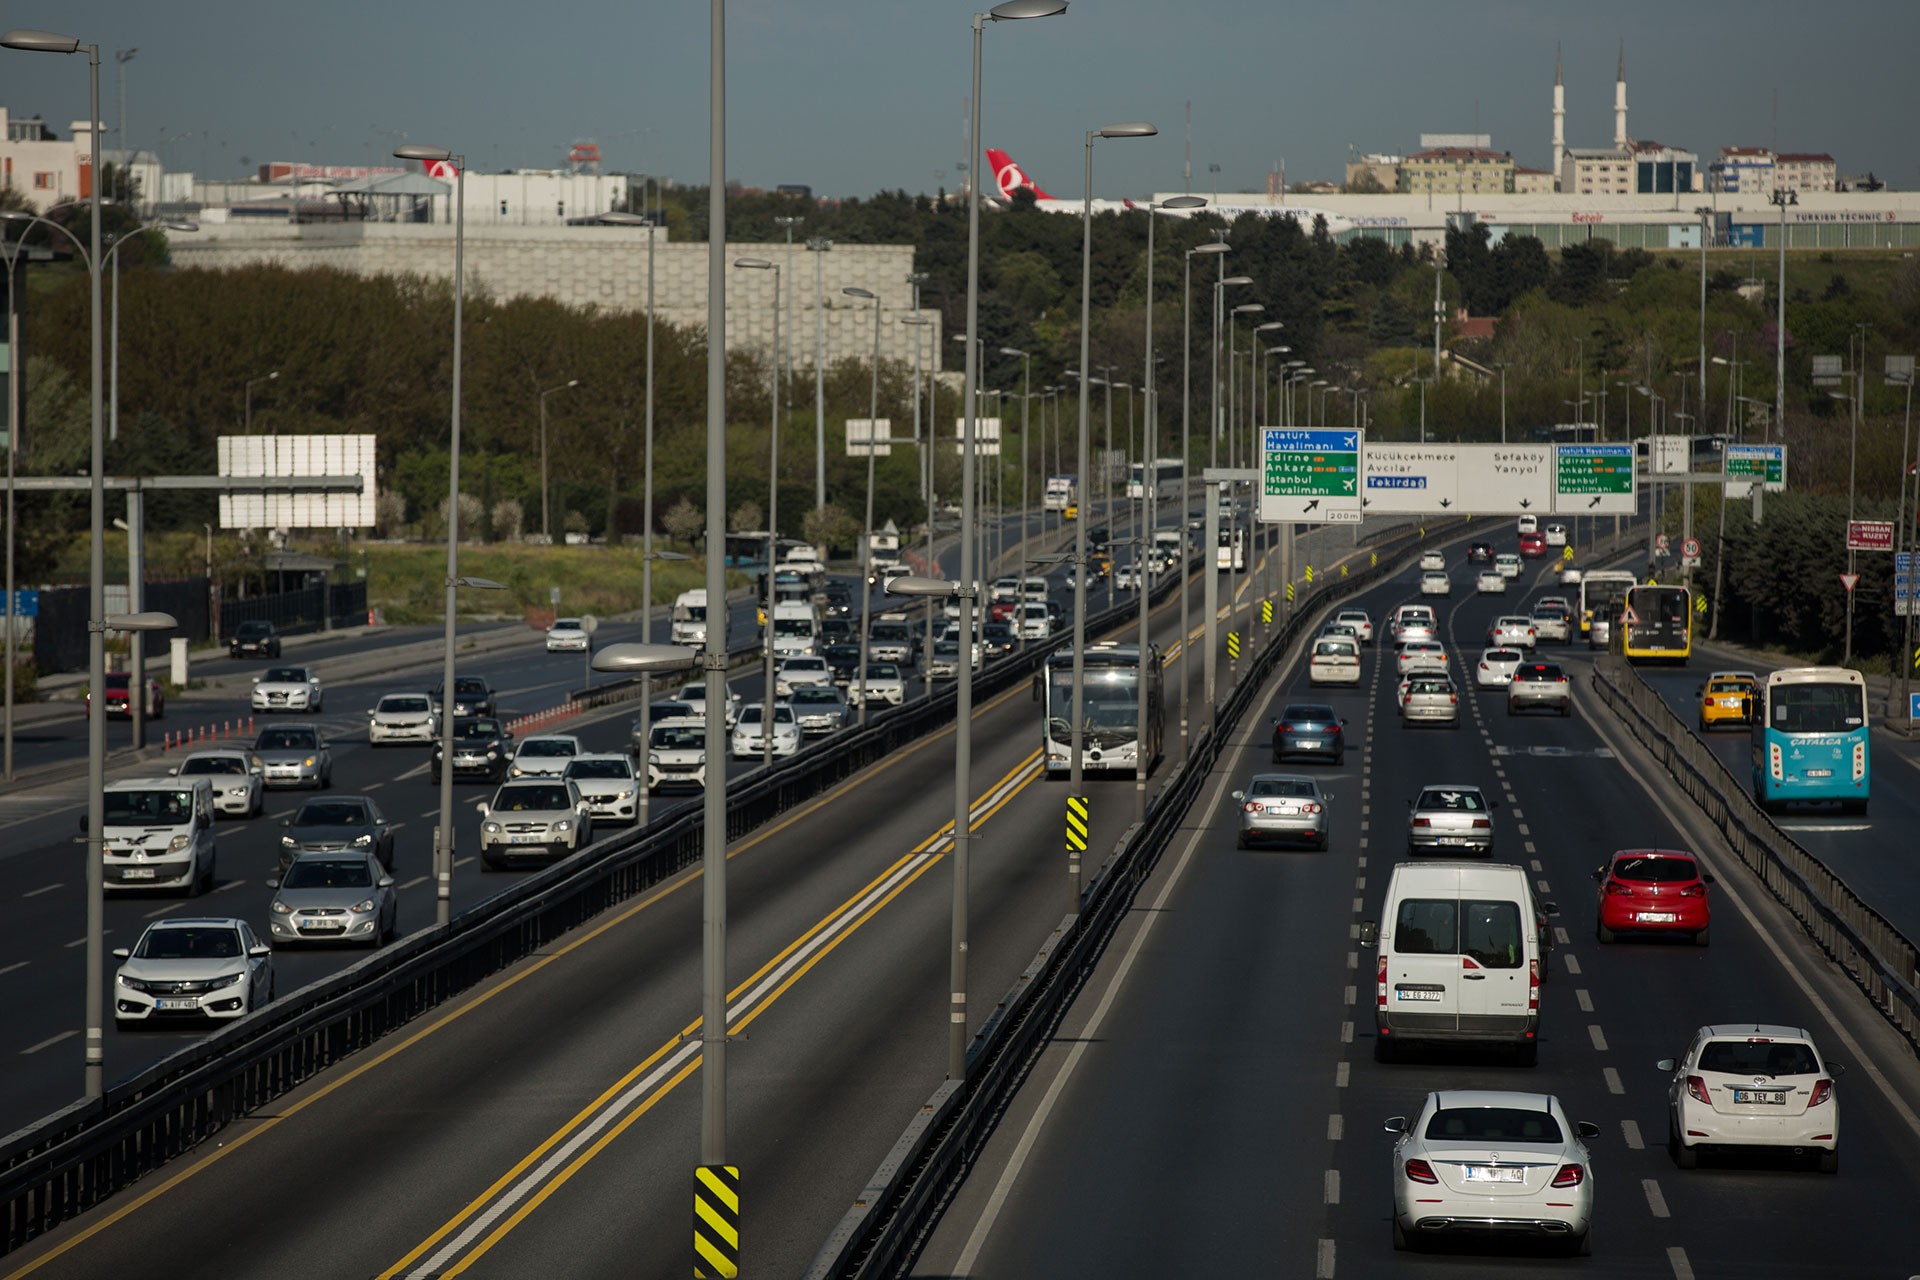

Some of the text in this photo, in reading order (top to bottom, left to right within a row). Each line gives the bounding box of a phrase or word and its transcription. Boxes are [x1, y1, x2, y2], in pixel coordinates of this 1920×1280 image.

[1840, 213, 1881, 221] TECHNIC
[1267, 431, 1310, 440] Atatürk
[1267, 441, 1334, 450] Havalimanı
[1266, 453, 1309, 462] Edirne
[1367, 452, 1456, 462] Küçükçekmece
[1494, 453, 1545, 463] Sefaköy
[1559, 457, 1592, 465] Edirne
[1266, 463, 1313, 472] Ankara
[1367, 464, 1412, 472] Avcılar
[1494, 465, 1538, 475] Yanyol
[1266, 473, 1312, 484] İstanbul
[1369, 477, 1425, 488] Tekirdağ
[1559, 475, 1598, 484] İstanbul
[1266, 485, 1329, 495] Havalimanı
[1861, 525, 1891, 533] NISSAN
[1686, 542, 1697, 553] 50
[1740, 1092, 1749, 1100] 06
[1774, 1093, 1784, 1101] 88
